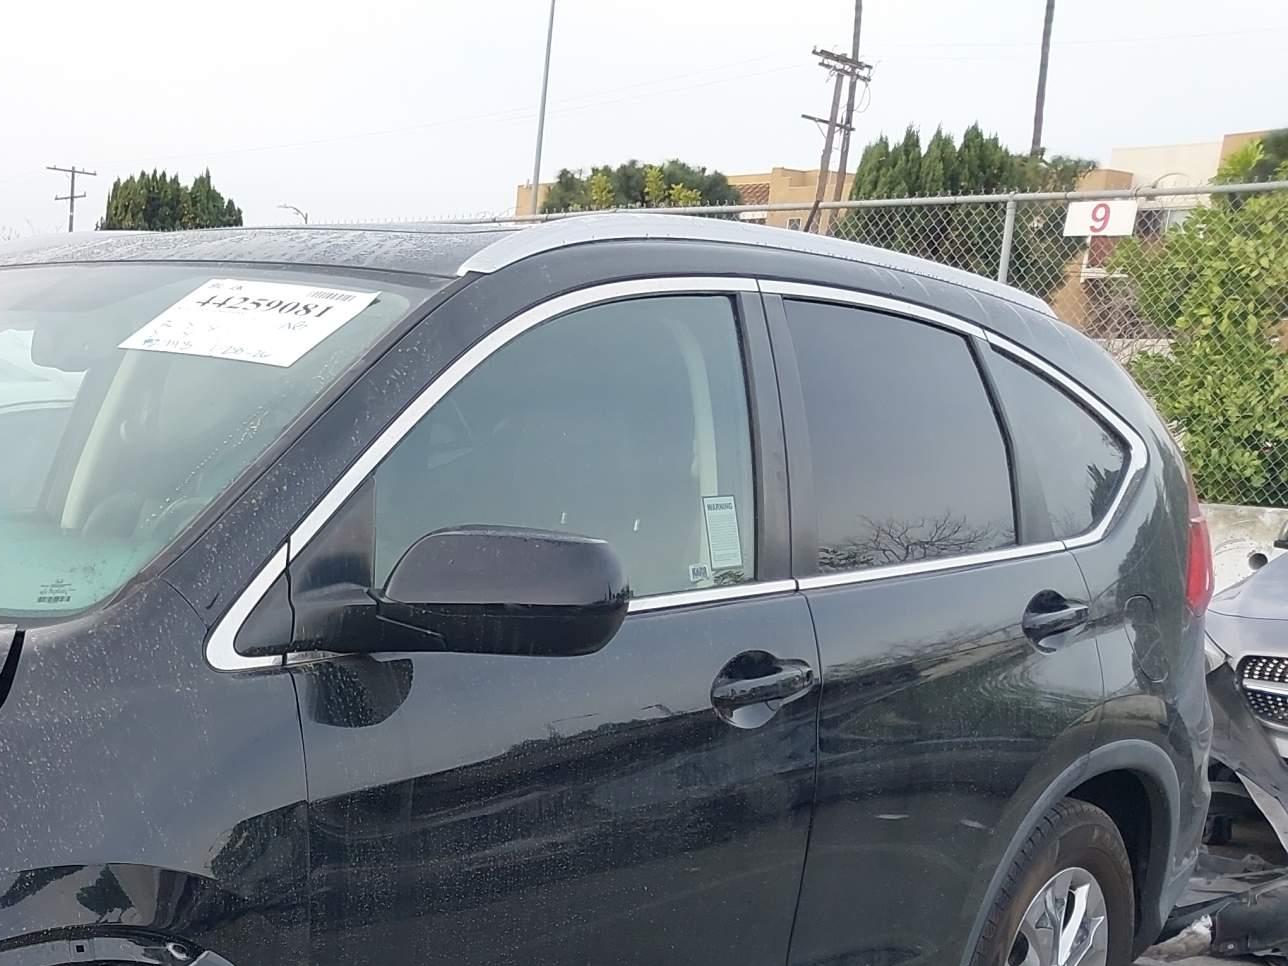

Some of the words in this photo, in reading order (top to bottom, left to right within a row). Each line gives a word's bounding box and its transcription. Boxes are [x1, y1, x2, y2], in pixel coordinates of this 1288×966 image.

[1089, 203, 1111, 233] 9
[196, 295, 334, 318] 44259081
[707, 503, 733, 511] WARNING
